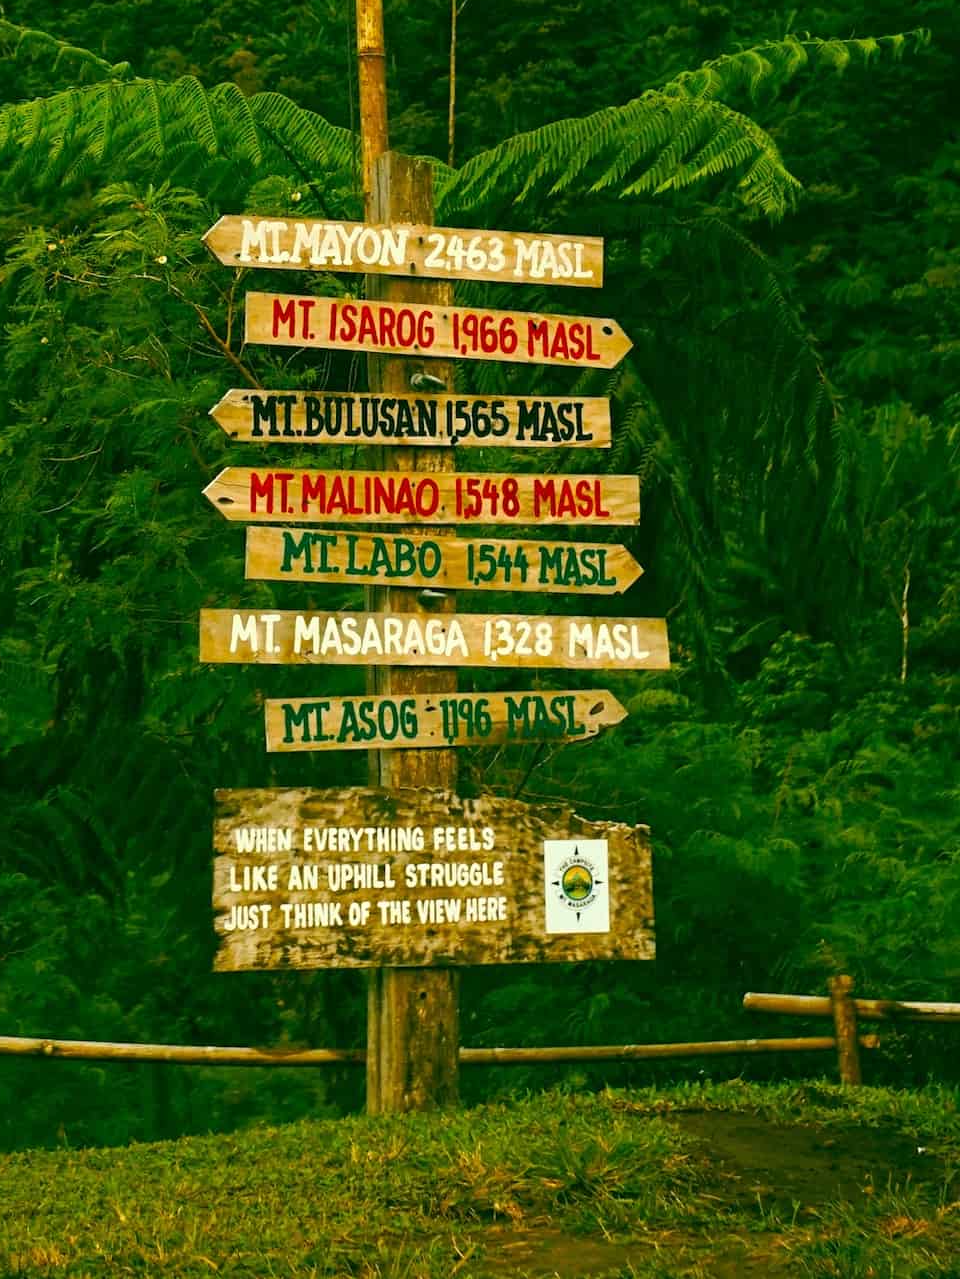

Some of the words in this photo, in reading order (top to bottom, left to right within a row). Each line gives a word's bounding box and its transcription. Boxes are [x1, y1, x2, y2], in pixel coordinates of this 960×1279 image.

[423, 233, 506, 271] 2,463
[513, 239, 594, 279] MASL
[272, 298, 316, 340] MT.
[329, 303, 435, 349] ISAROG
[451, 312, 519, 356] 1,966
[527, 319, 601, 361] MASL
[516, 401, 594, 441] MASL
[302, 474, 440, 517] MALINAO
[455, 478, 520, 519] 1,548
[533, 480, 610, 518] MASL
[467, 544, 529, 586] 1,544
[538, 546, 617, 587] MASL
[230, 614, 282, 654] MT.
[293, 616, 469, 657] MASARAGA
[484, 620, 553, 662] 1,328
[568, 623, 649, 660] MASL
[505, 695, 586, 738] MASL
[235, 827, 292, 853] WHEN
[303, 826, 424, 852] EVERYTHING
[433, 826, 495, 851] FEELS
[229, 865, 278, 892] LIKE
[288, 864, 319, 891] AN
[327, 863, 396, 891] UPHILL
[405, 861, 505, 888] STRUGGLE
[223, 904, 271, 931] JUST
[283, 902, 343, 929] THINK
[348, 901, 371, 926] OF
[377, 900, 412, 925] THE
[417, 898, 461, 923] VIEW
[465, 897, 508, 923] HERE
